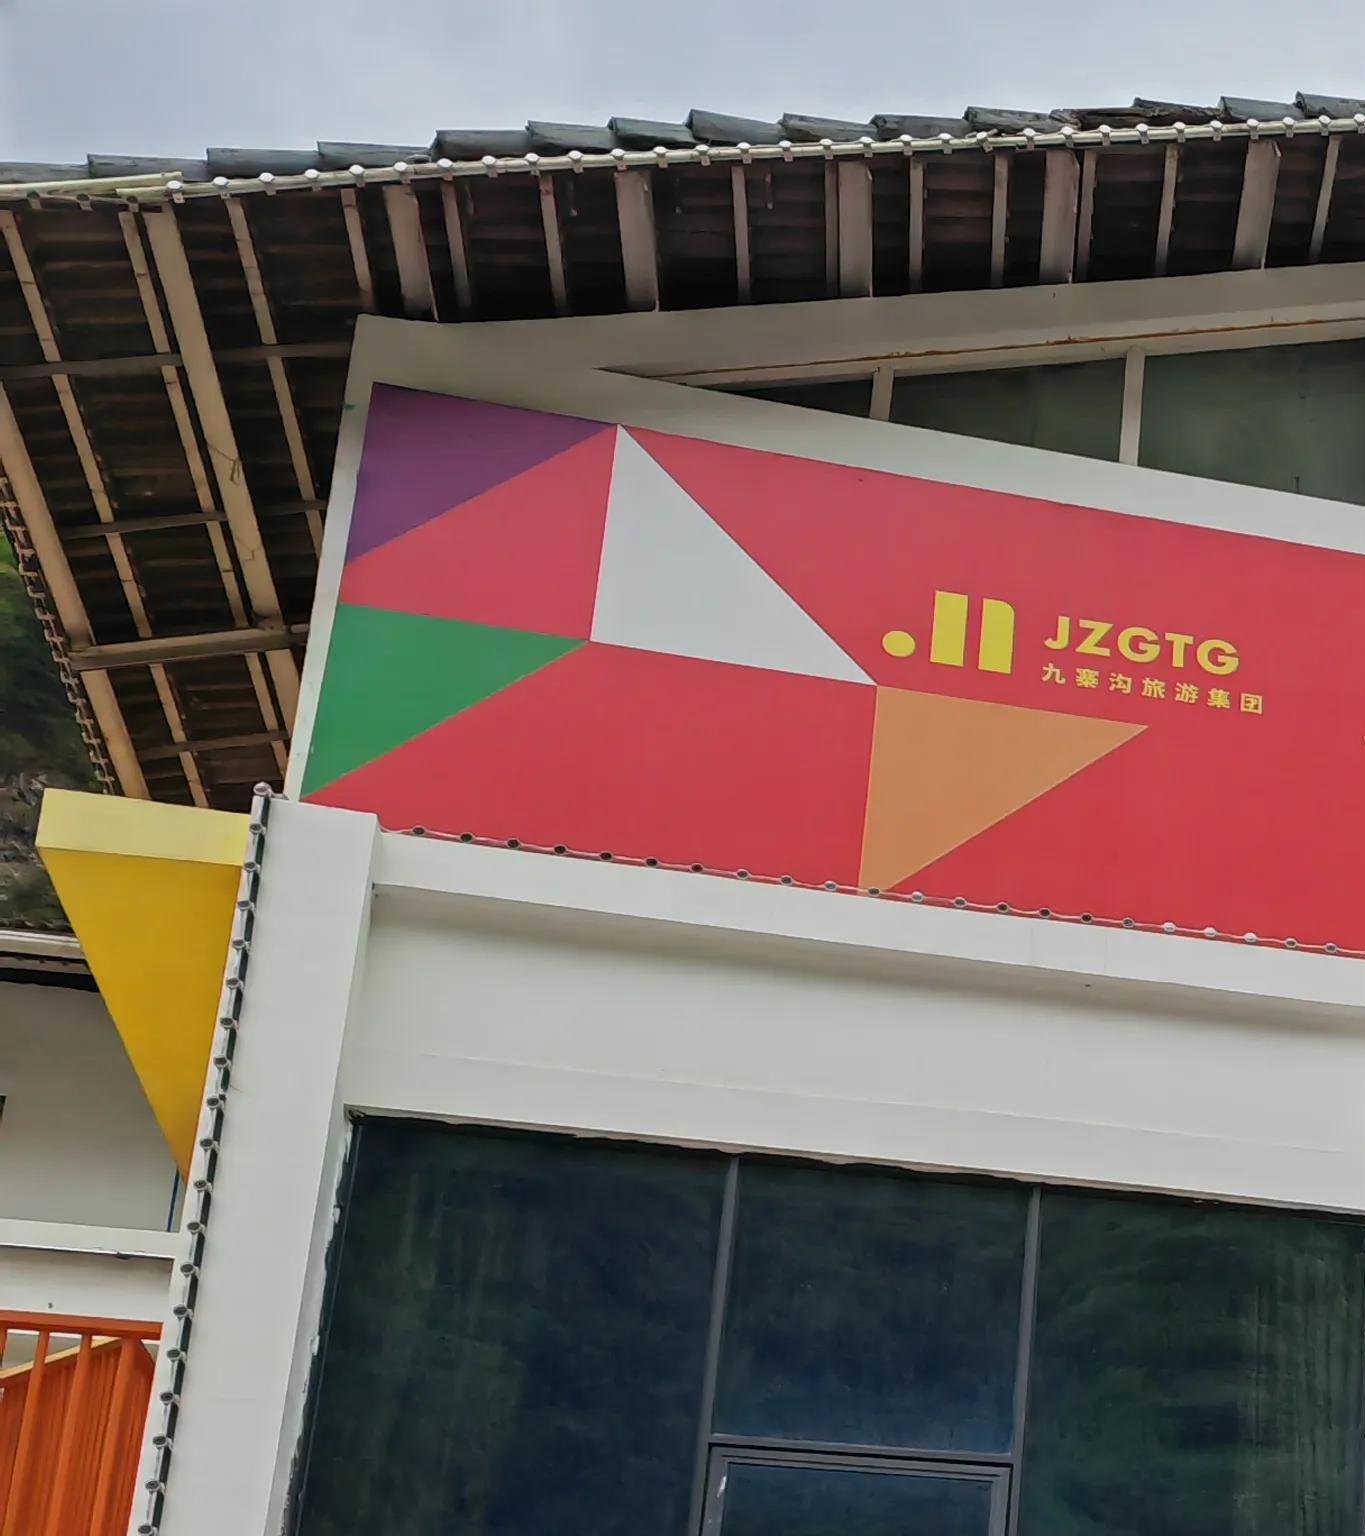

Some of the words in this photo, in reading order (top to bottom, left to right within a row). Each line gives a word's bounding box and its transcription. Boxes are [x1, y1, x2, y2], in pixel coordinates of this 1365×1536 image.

[1044, 615, 1240, 676] JZGTG
[1042, 662, 1263, 714] 九寨沟旅游集团
